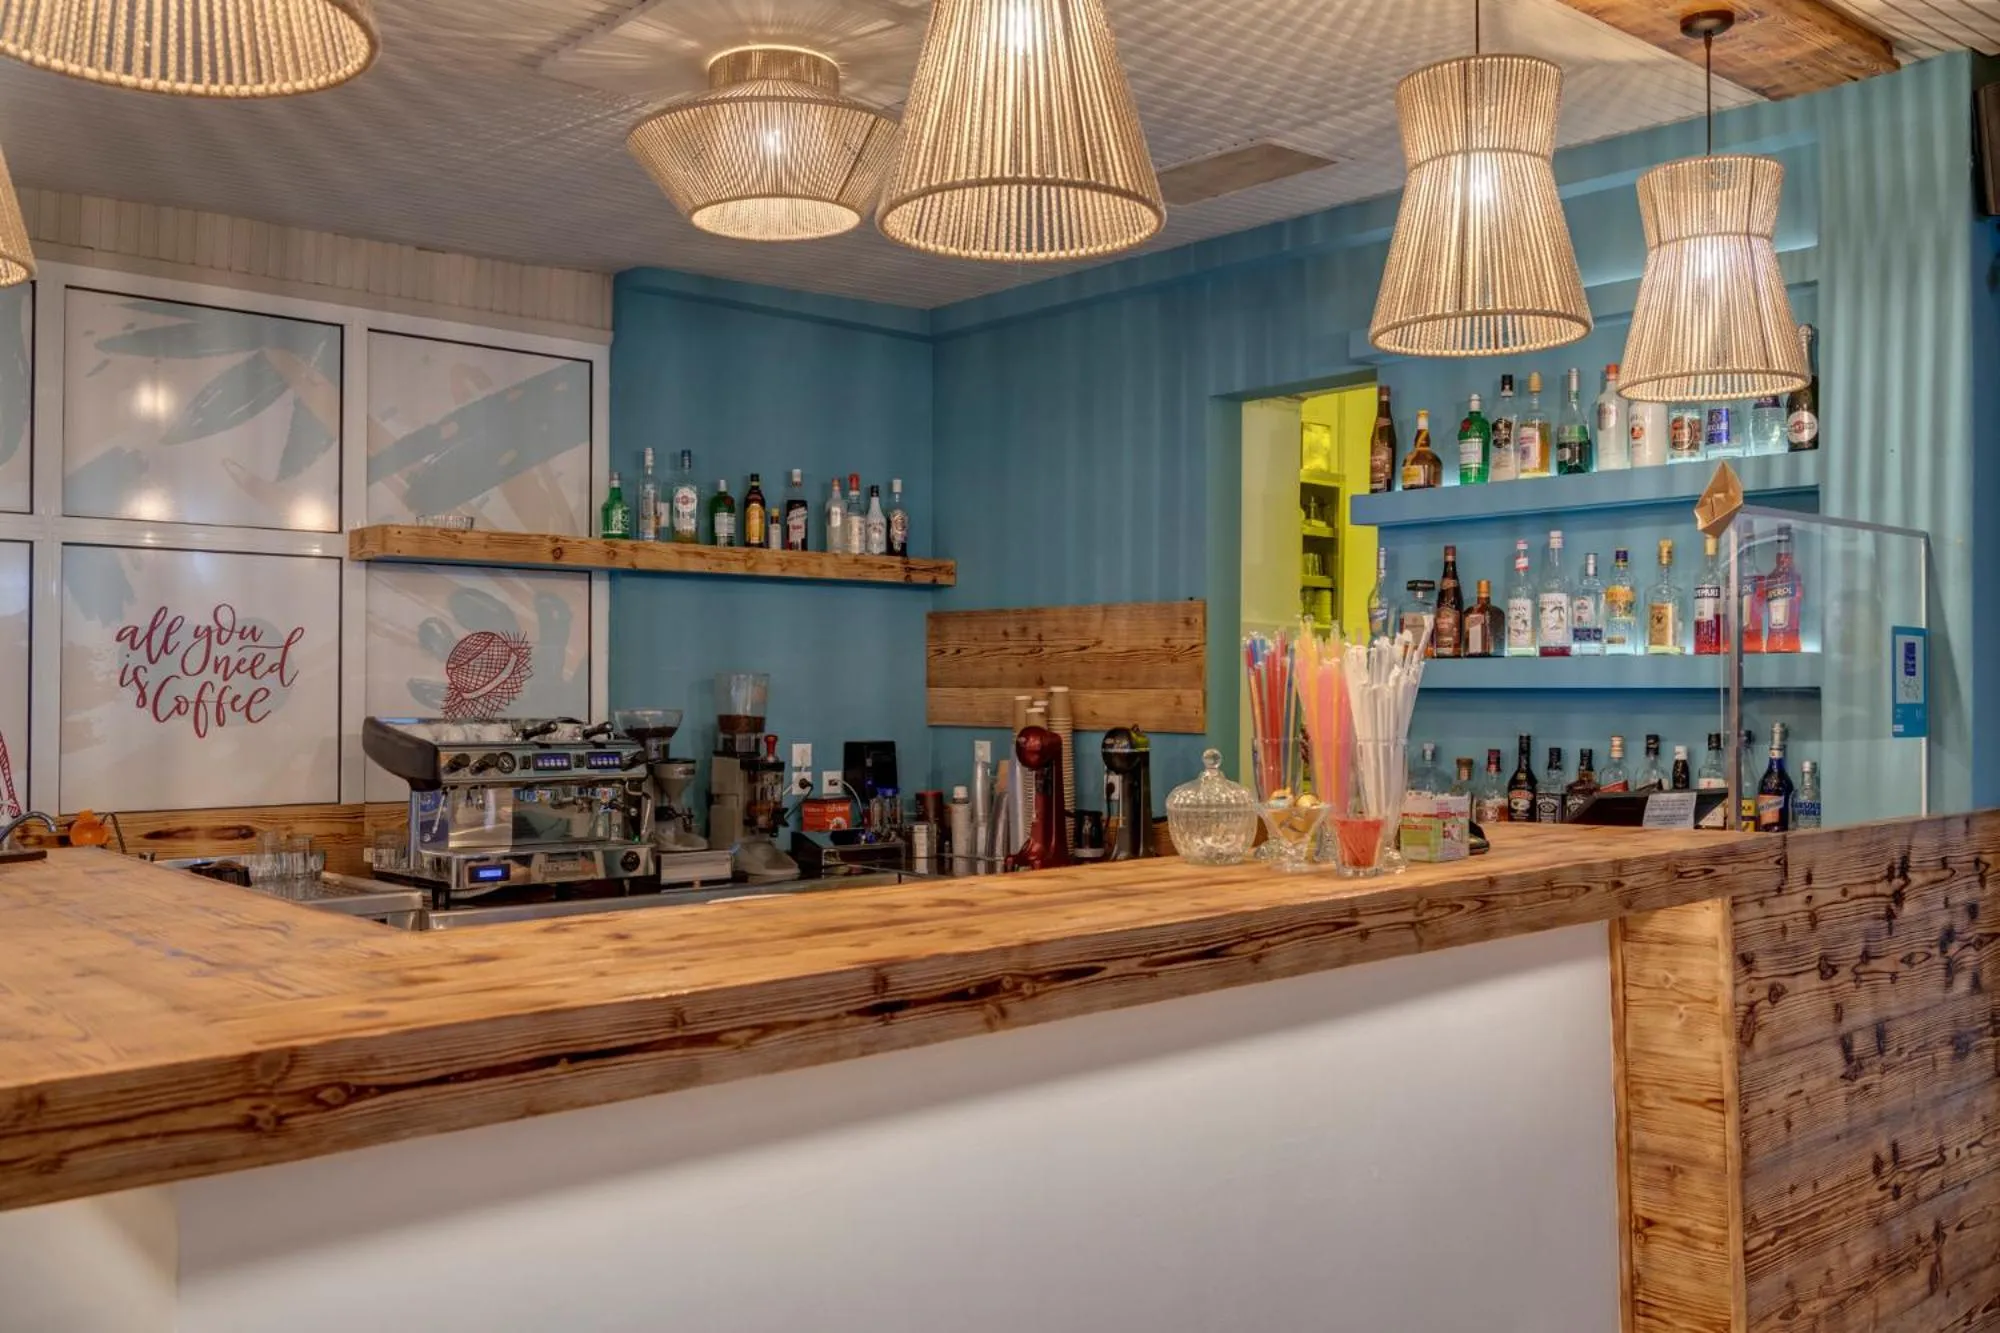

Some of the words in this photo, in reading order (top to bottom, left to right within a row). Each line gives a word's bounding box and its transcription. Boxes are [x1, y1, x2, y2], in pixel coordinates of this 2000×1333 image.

[115, 606, 185, 665] all
[181, 603, 263, 676] you
[213, 627, 305, 687] need
[119, 653, 149, 709] is
